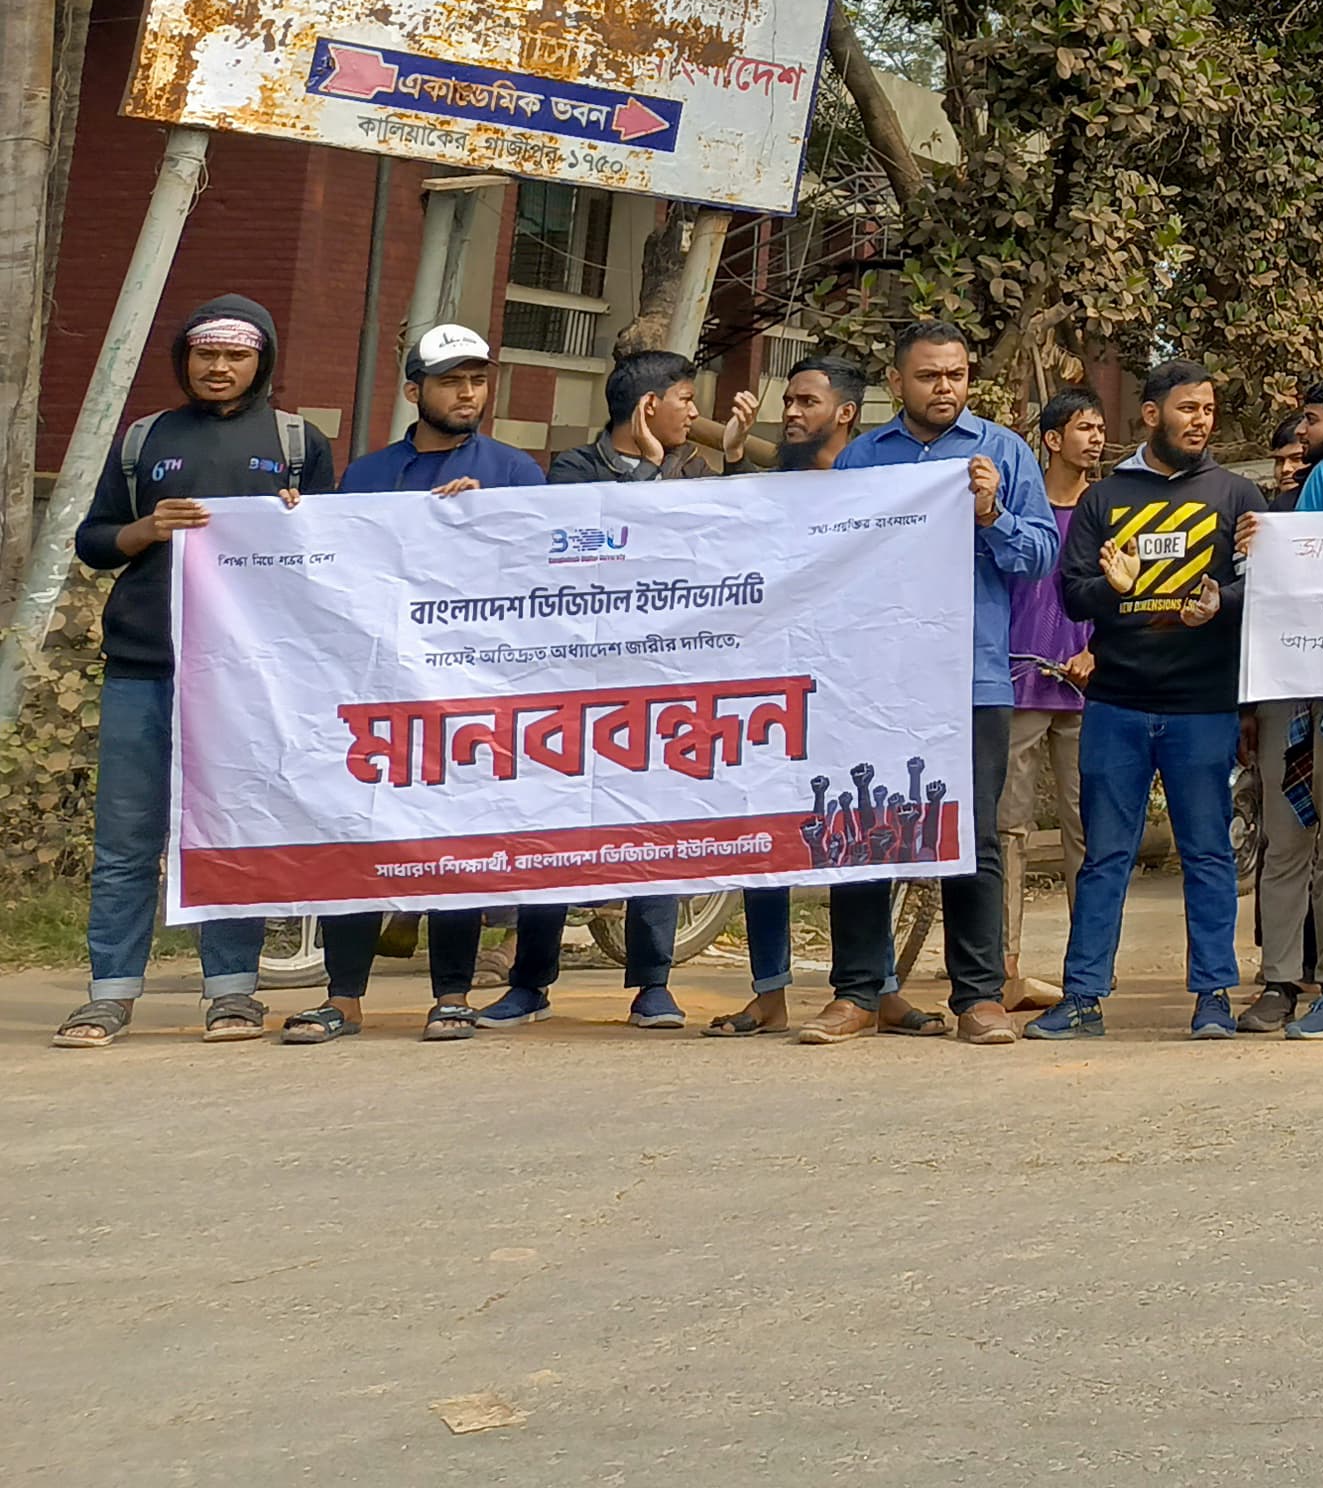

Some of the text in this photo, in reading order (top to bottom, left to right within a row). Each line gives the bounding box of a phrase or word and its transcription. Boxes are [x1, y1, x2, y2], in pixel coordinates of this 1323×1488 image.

[550, 95, 612, 132] ভবন
[152, 458, 183, 482] 6TH
[1144, 537, 1181, 555] CORE
[410, 572, 765, 625] বাংলাদেশ ডিজিটাল ইউনিভার্সিটি
[425, 646, 475, 667] নামেই
[337, 674, 816, 788] মানববন্ধন
[374, 859, 437, 879] সাধারণ
[514, 847, 598, 871] বাংলাদেশ
[600, 841, 674, 866] ডিজিটাল
[676, 832, 773, 860] ইউনিভার্সিটি
